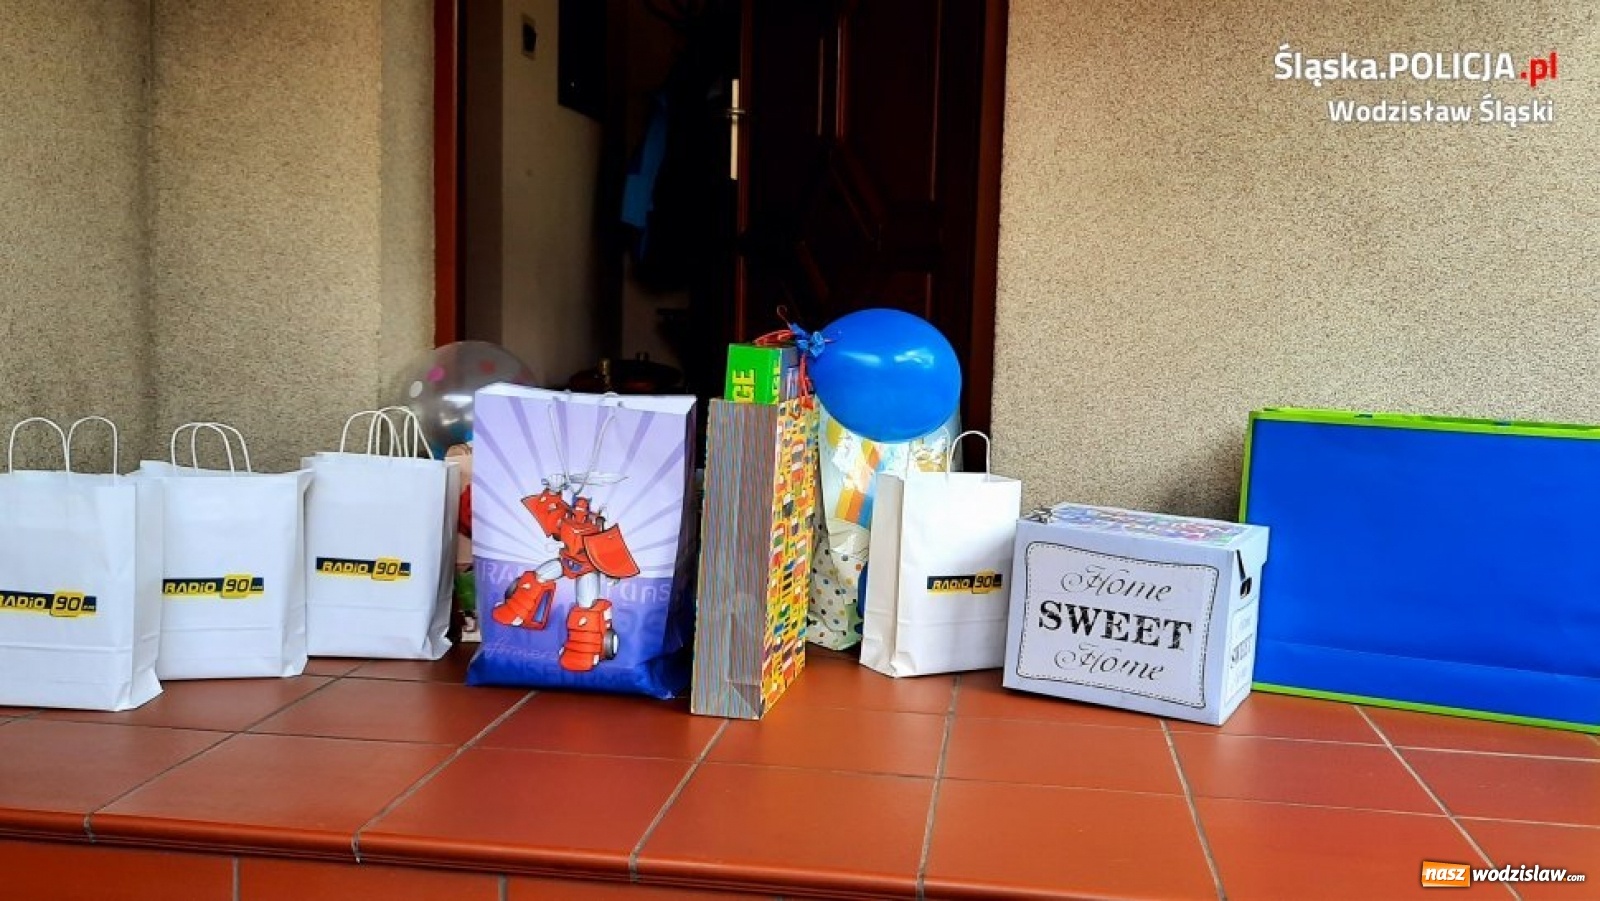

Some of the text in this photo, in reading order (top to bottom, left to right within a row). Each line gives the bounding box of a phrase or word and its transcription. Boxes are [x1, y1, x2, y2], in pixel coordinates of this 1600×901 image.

[375, 562, 399, 575] 90
[225, 578, 250, 593] 90
[1061, 565, 1172, 602] Home
[55, 595, 82, 611] 90
[1038, 600, 1193, 651] SWEET
[1053, 642, 1165, 681] Home
